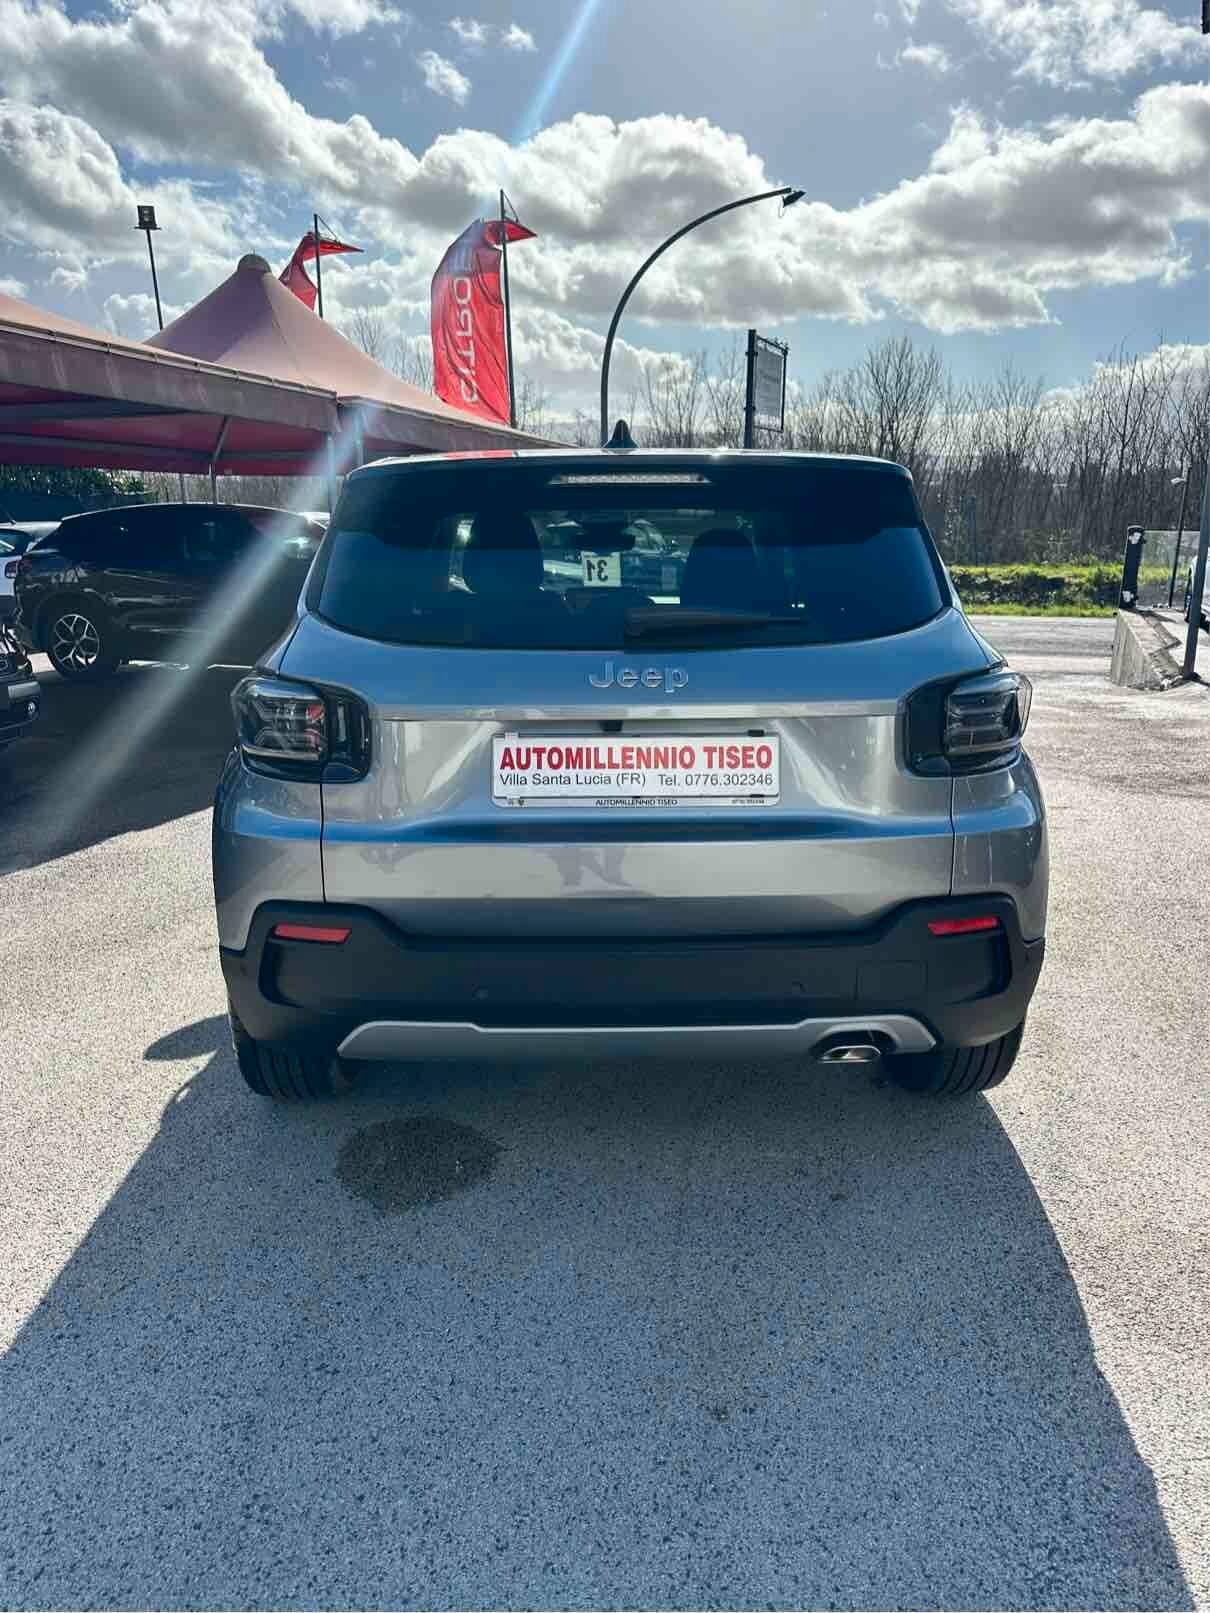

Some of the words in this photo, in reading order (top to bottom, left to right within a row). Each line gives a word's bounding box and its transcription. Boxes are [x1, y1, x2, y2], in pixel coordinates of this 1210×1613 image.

[588, 660, 689, 693] Jeep
[500, 745, 696, 770] AUTOMILLENNIO
[702, 745, 773, 769] TISEO
[500, 773, 528, 785] Villa
[532, 773, 571, 785] Santa
[576, 773, 612, 785] Lucia
[616, 772, 646, 787] (FR)
[684, 774, 773, 786] 0776.302346
